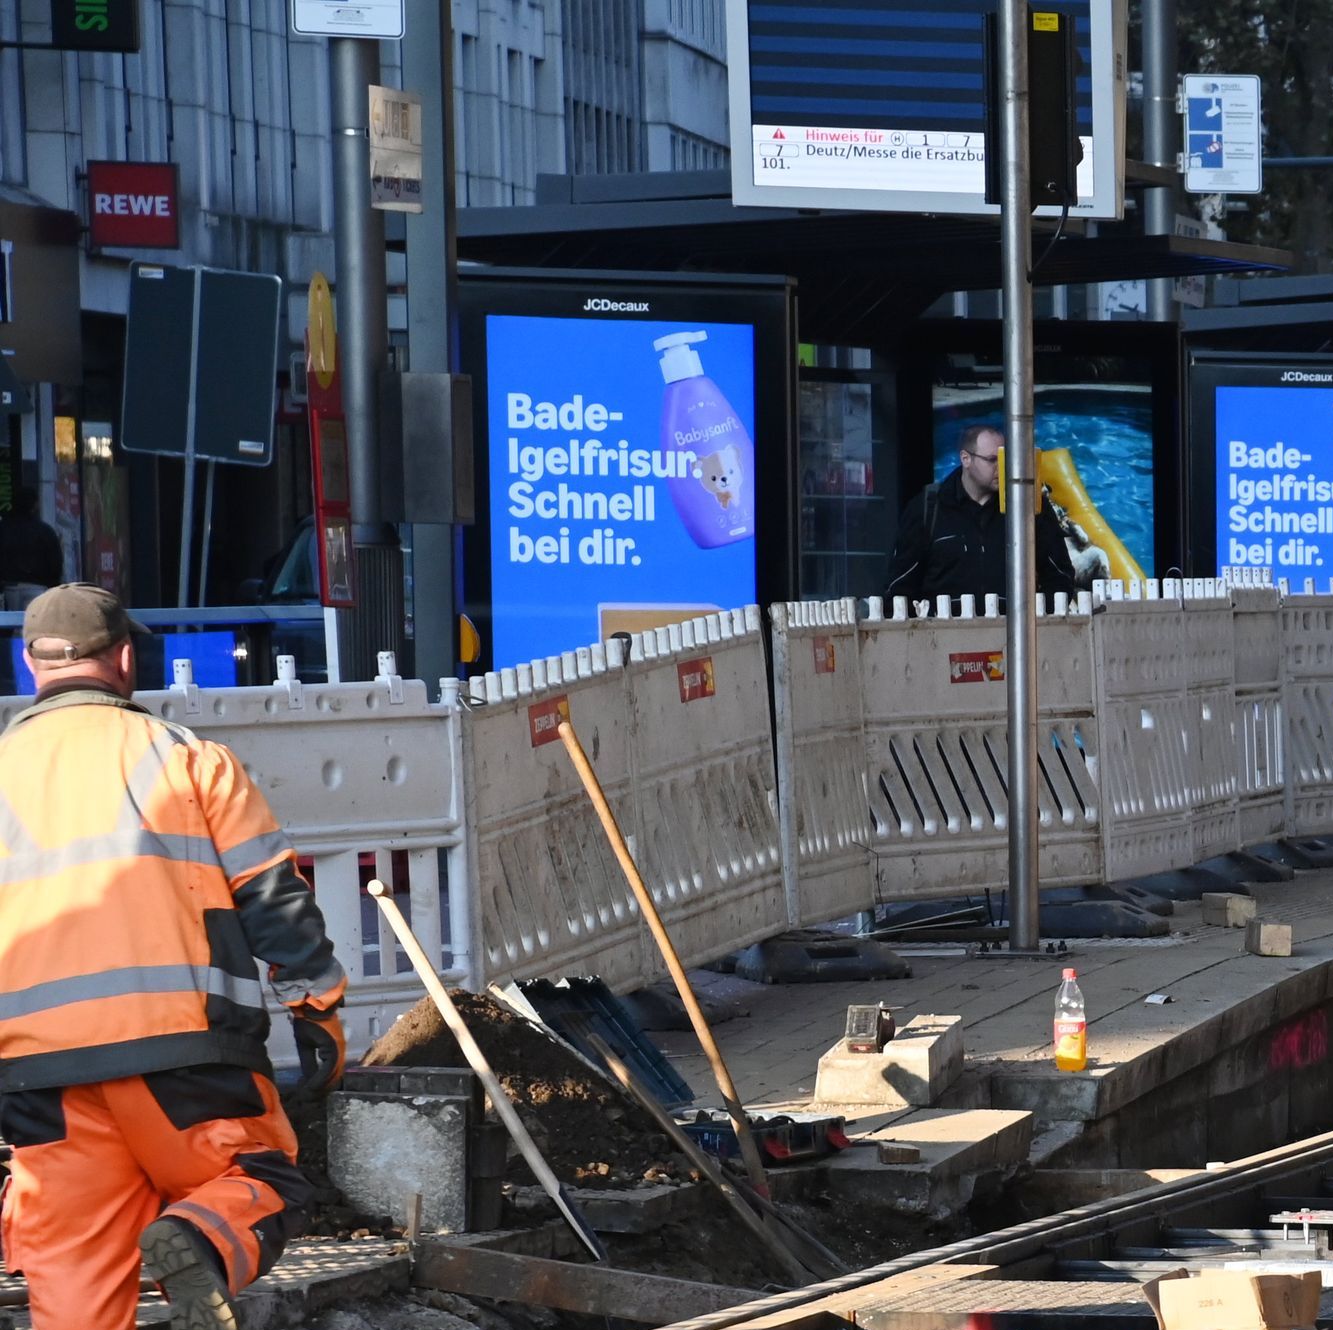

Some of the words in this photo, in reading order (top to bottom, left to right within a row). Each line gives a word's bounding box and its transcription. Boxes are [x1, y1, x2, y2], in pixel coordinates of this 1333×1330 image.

[775, 145, 783, 158] 7
[806, 144, 898, 160] Deutz/Messe
[901, 147, 923, 160] die
[805, 129, 861, 143] Hinweis
[863, 131, 884, 144] für
[922, 134, 929, 146] 1
[963, 135, 971, 147] 7
[761, 157, 791, 170] 101.
[94, 193, 171, 217] REWE
[583, 298, 650, 312] JCDecaux
[1281, 371, 1333, 382] JCDecaux
[507, 392, 623, 432] Bade-
[674, 416, 739, 447] Babysanft
[508, 436, 703, 482] Igelfrisur.
[1229, 440, 1312, 469] Bade-
[508, 481, 655, 521] Schnell
[1229, 505, 1333, 534] Schnell
[509, 526, 571, 564] bei
[578, 528, 642, 566] dir.
[1229, 537, 1273, 565] bei
[1278, 538, 1323, 566] dir.
